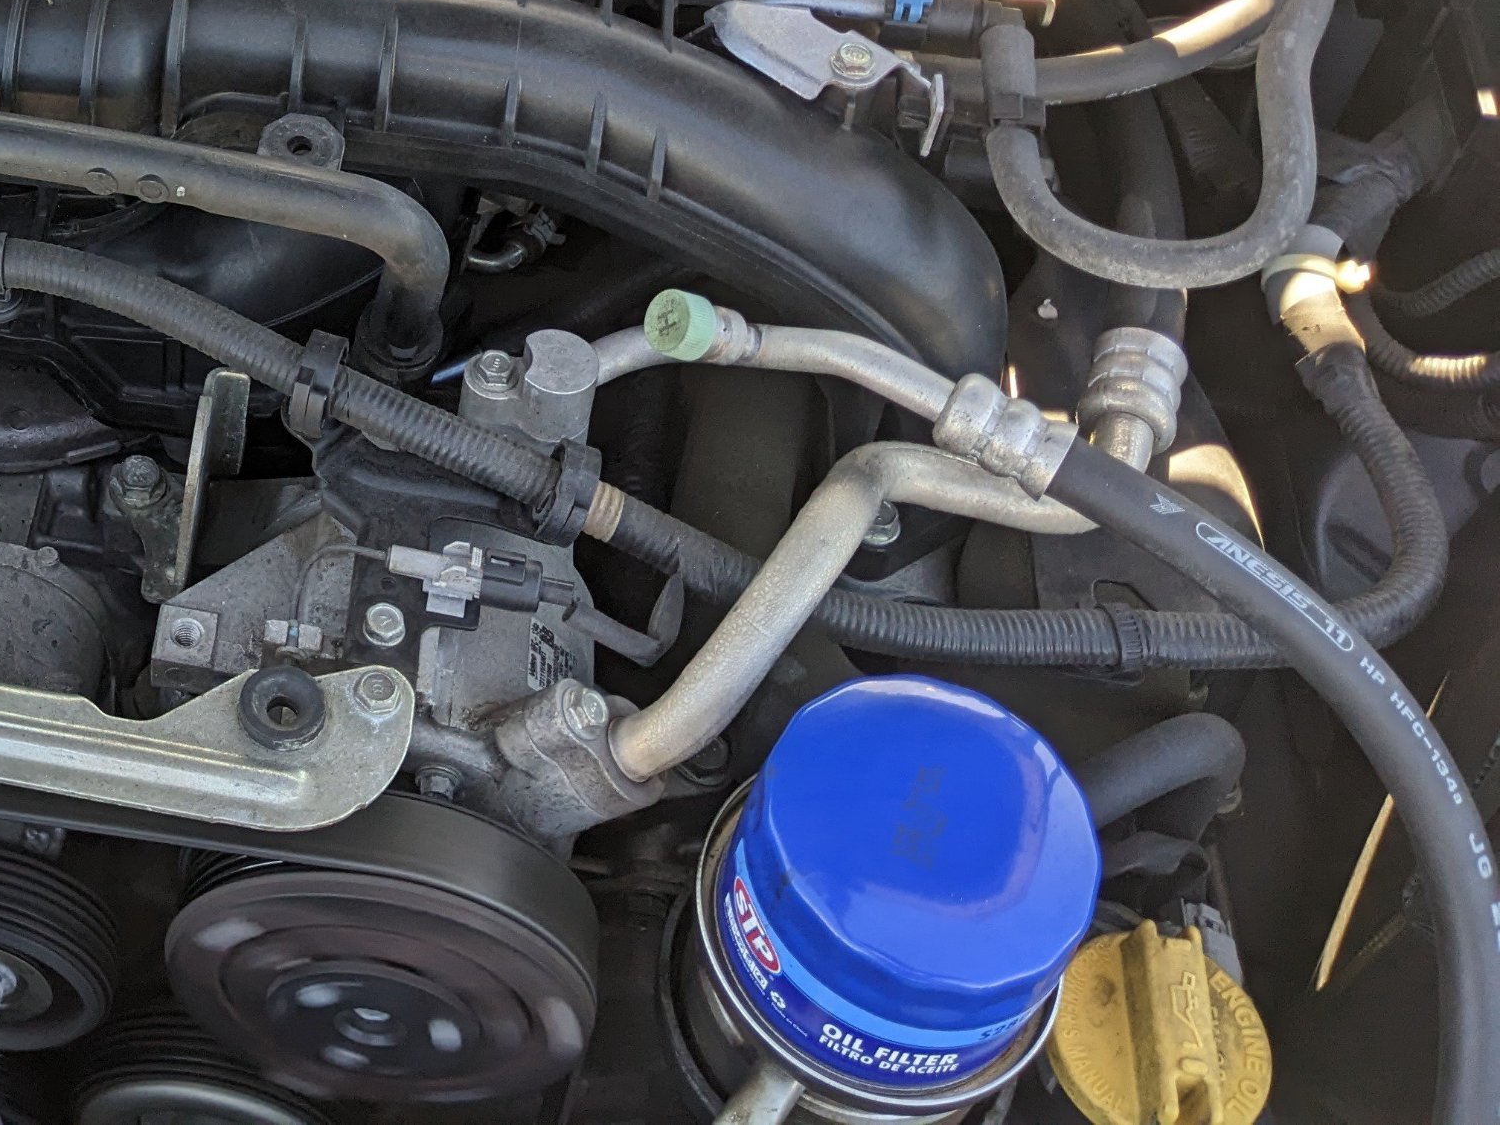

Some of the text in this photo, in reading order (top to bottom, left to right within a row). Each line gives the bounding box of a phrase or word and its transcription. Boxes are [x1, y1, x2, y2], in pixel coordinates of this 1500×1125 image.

[1206, 536, 1313, 609] ANESIS
[1324, 618, 1347, 644] 11
[1359, 656, 1386, 685] HP
[1389, 691, 1463, 805] HFC-134a
[735, 888, 775, 963] STP
[819, 1035, 960, 1075] FILTRO DE ACEITE
[822, 1023, 959, 1067] OIL FILTER
[1209, 969, 1264, 1112] ENGINE OIL
